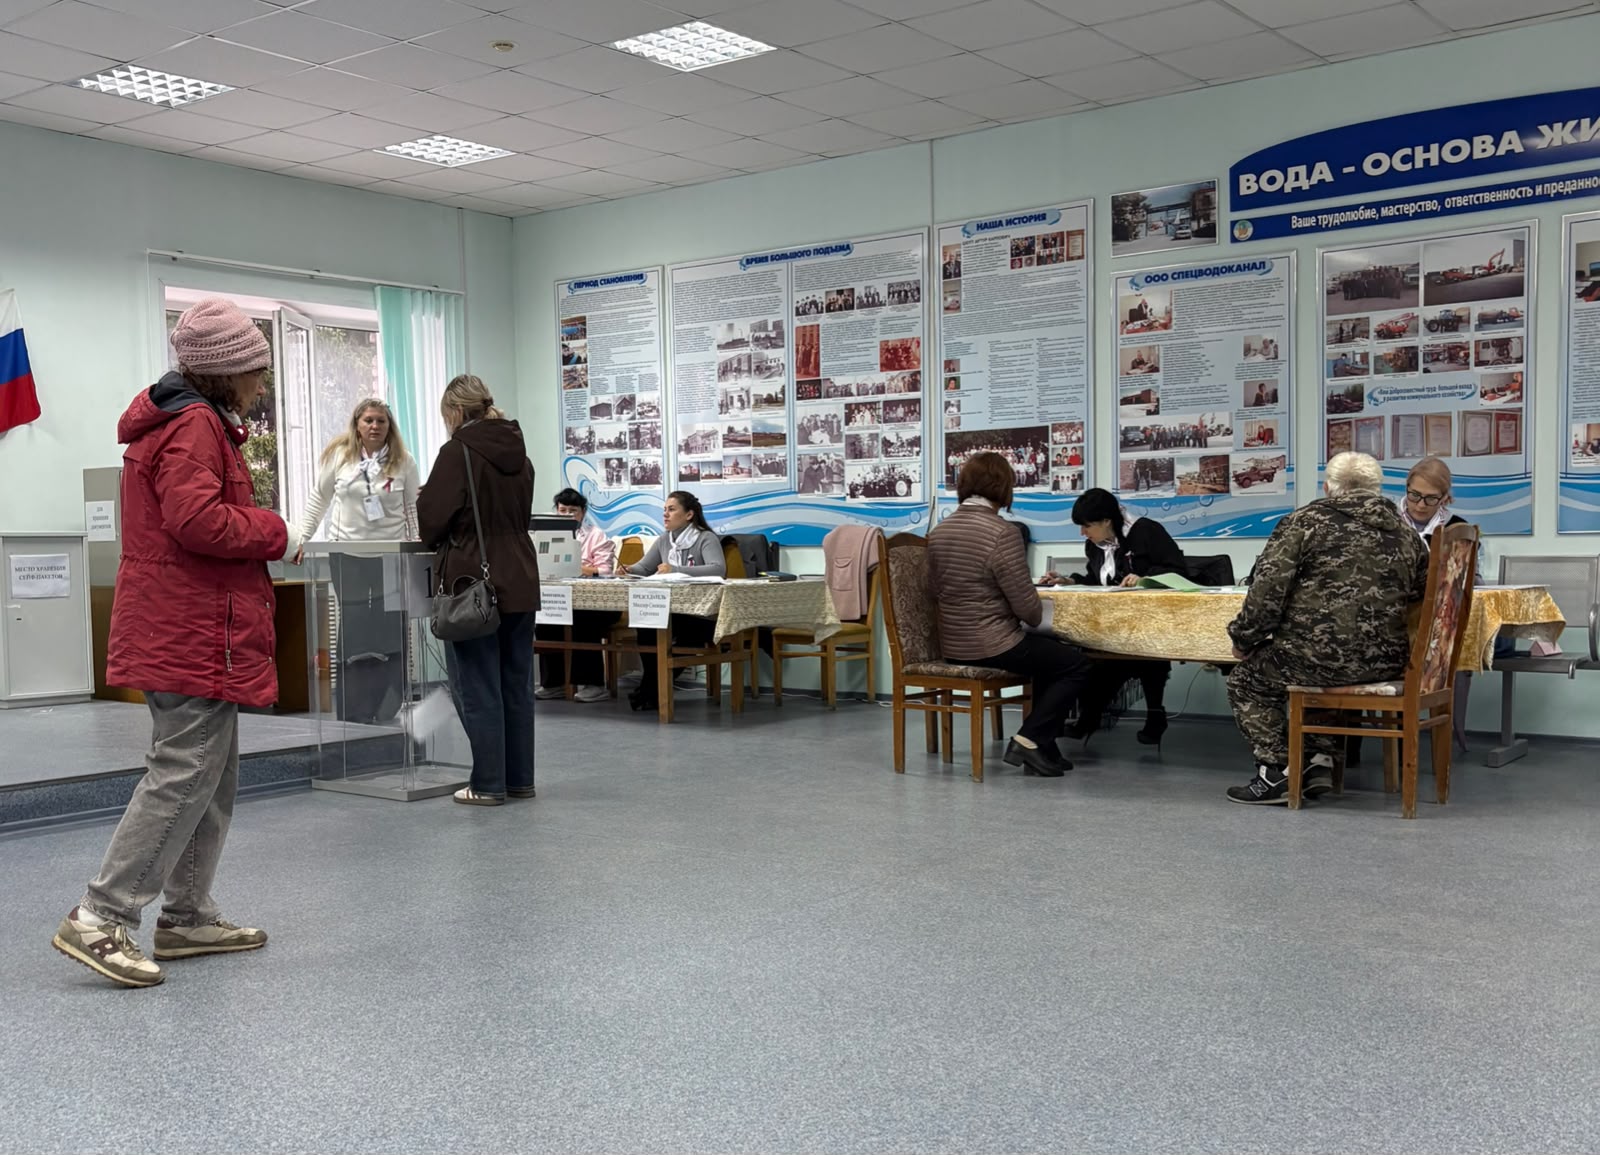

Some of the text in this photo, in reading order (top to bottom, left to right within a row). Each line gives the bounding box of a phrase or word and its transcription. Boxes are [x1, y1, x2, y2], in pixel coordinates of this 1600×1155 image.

[1238, 161, 1334, 196] ВОДА
[1342, 165, 1356, 174] -
[1362, 130, 1524, 176] ОСНОВА
[1291, 176, 1600, 228] Ваше трудолюбие, мастерство, ответственность и преданно
[976, 213, 1047, 231] НАША ИСТОРИЯ
[745, 255, 769, 265] ВРЕМЯ
[770, 249, 812, 261] БОЛЬШОГО
[574, 273, 644, 289] ПЕРИОД СТАНОВЛЕНИЯ
[1144, 261, 1266, 283] ООО СПЕЦВОДОКАНАЛ
